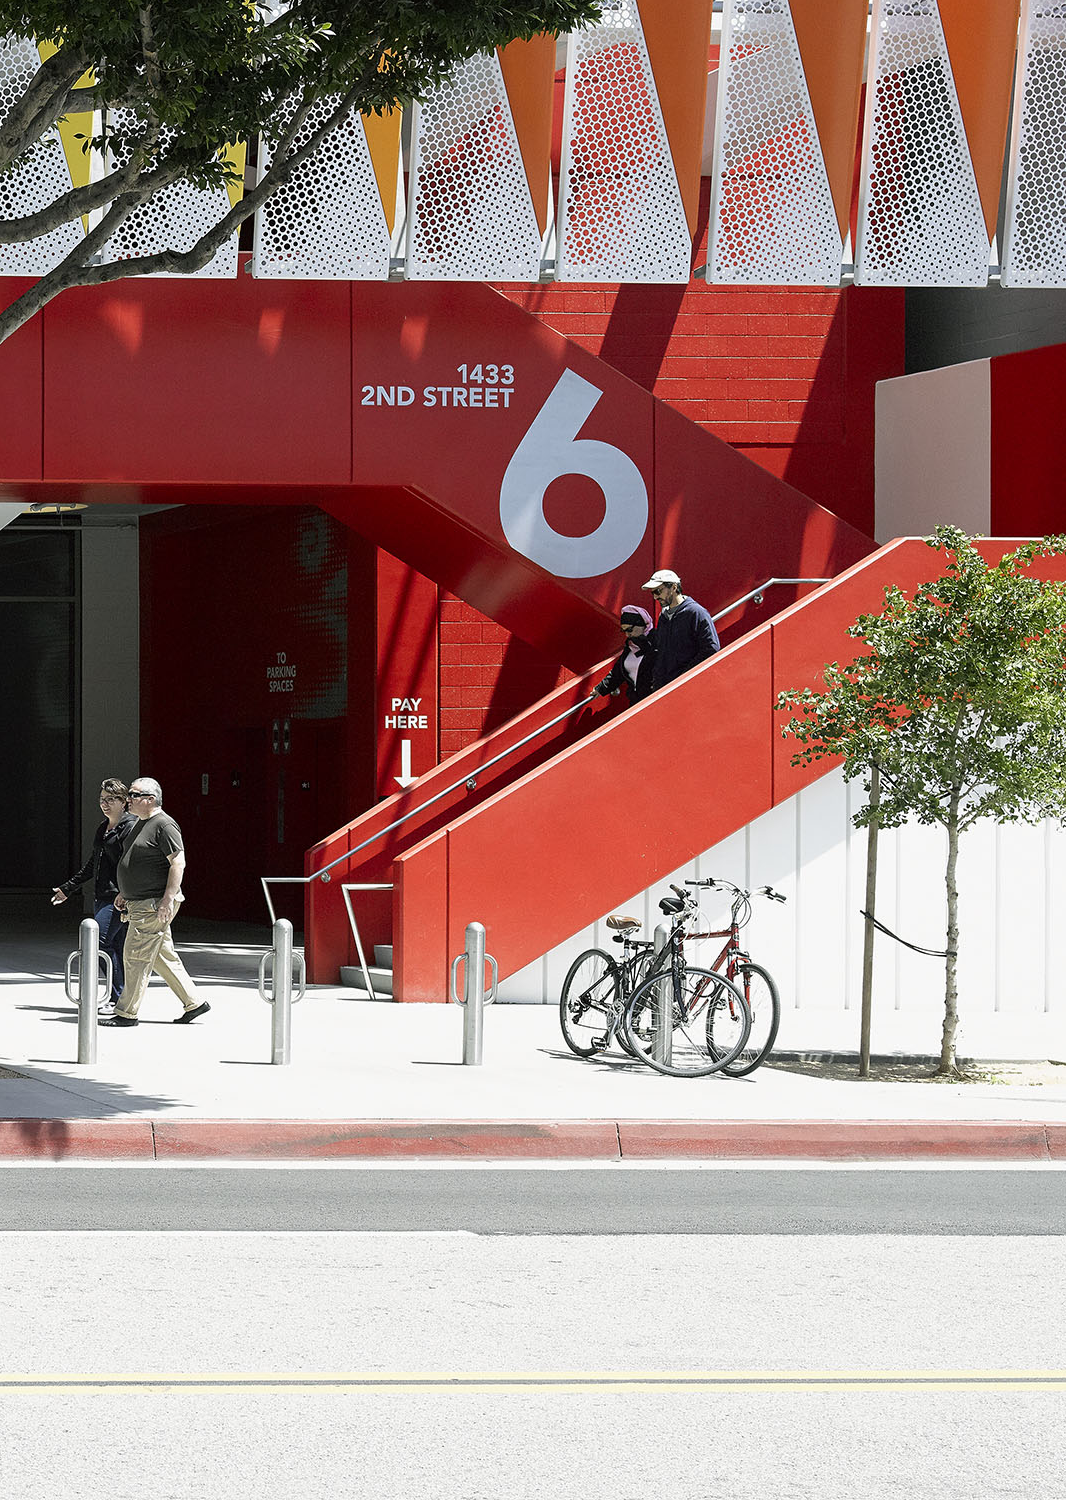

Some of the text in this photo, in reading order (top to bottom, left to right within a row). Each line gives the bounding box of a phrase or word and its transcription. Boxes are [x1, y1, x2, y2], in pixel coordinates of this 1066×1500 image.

[456, 363, 515, 385] 1433
[360, 385, 515, 408] 2ND STREET
[499, 367, 649, 579] 6
[276, 651, 287, 664] TO
[266, 664, 297, 679] PARKING
[269, 679, 294, 692] SPACES
[391, 697, 423, 712] PAY
[384, 715, 428, 729] HERE
